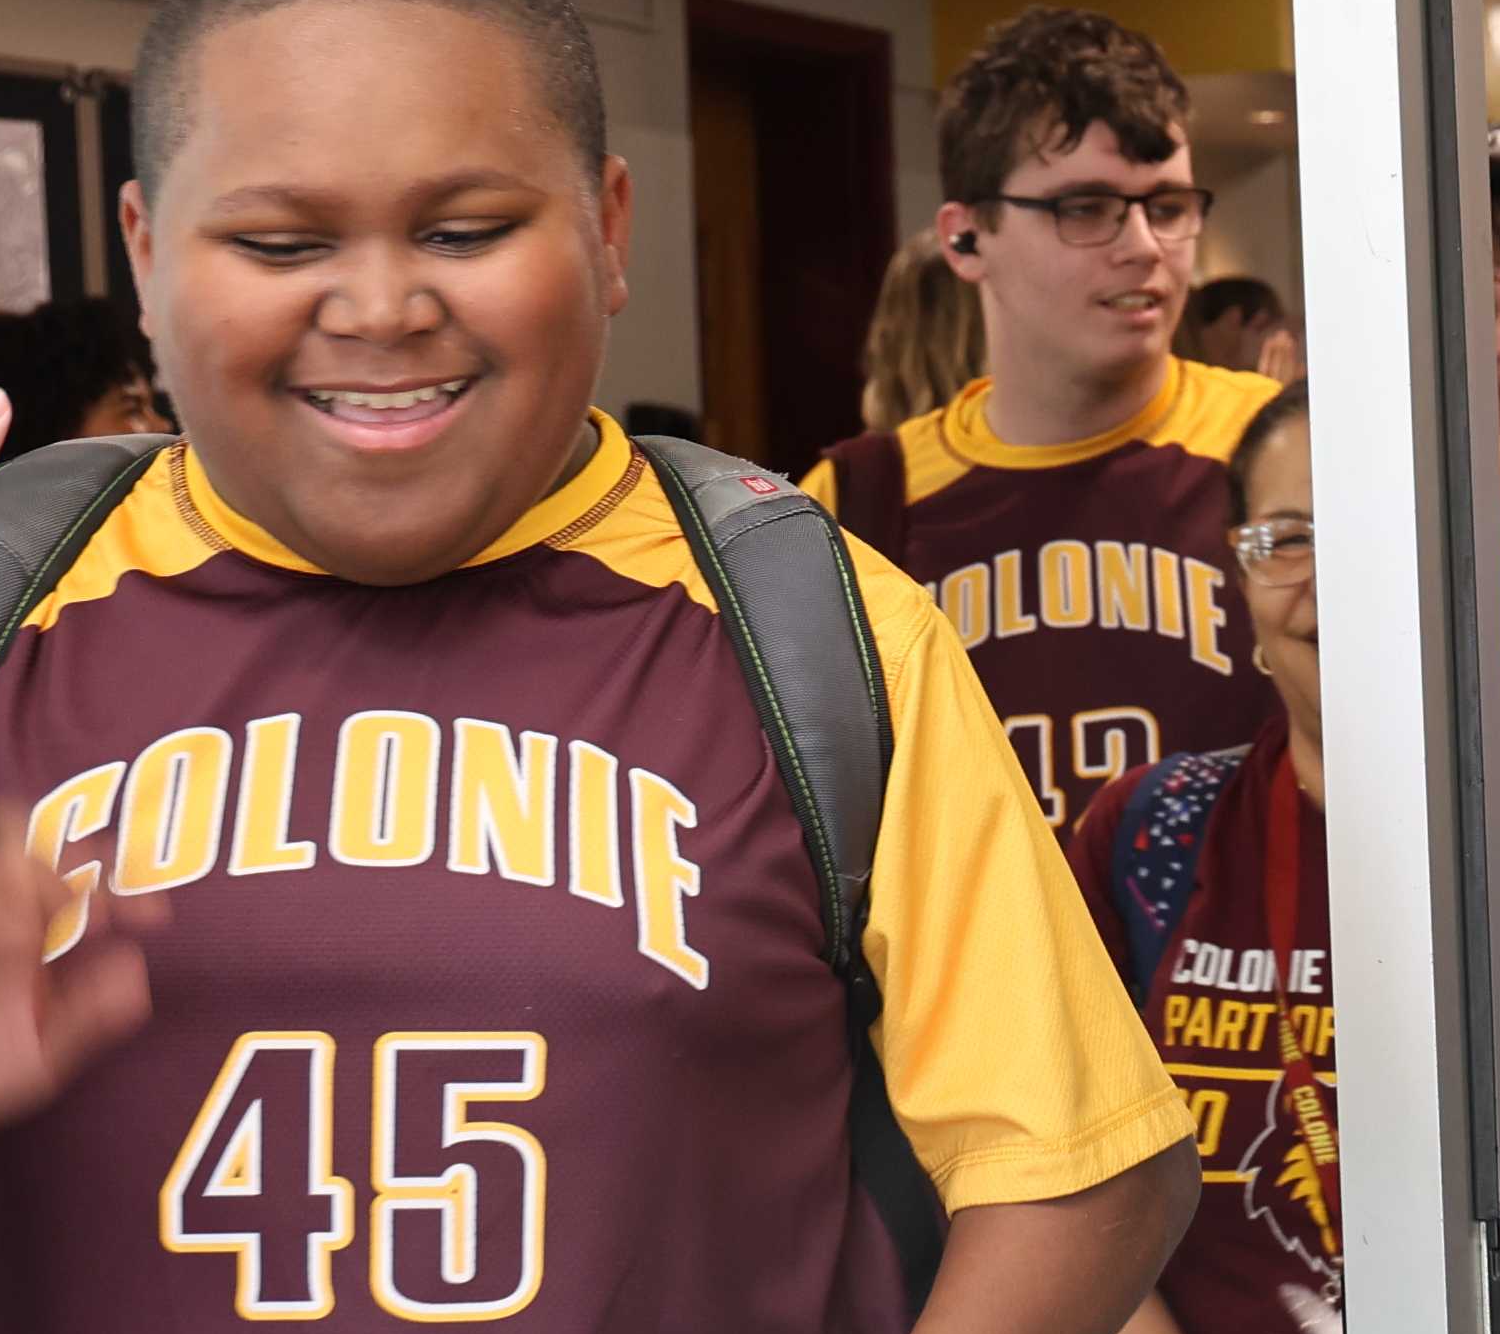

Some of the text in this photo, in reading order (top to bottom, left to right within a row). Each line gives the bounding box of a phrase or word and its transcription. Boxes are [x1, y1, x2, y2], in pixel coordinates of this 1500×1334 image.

[931, 539, 1233, 676] OLONIE
[25, 710, 709, 990] COLONIE
[1162, 994, 1278, 1053] PART
[158, 1030, 548, 1323] 45
